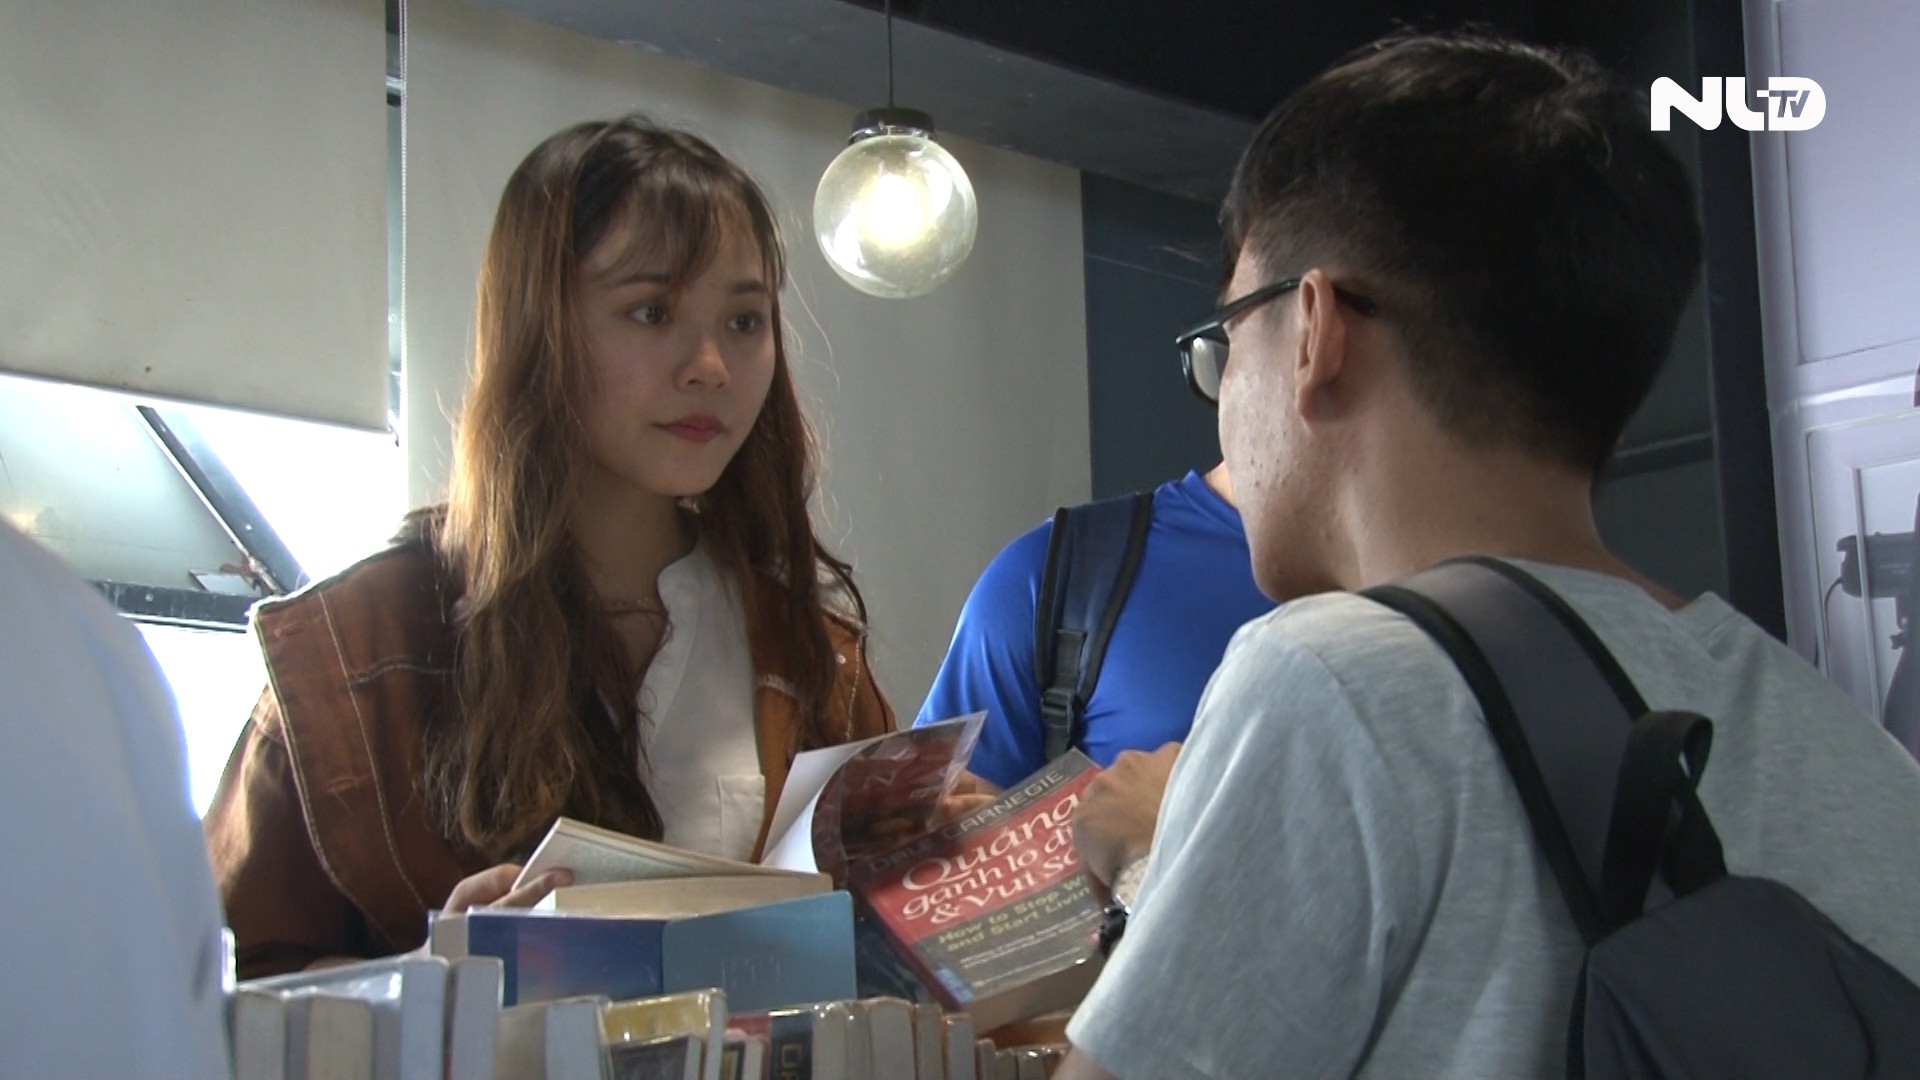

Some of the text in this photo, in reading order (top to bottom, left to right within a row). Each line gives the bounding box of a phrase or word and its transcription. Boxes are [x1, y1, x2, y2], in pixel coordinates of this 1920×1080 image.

[943, 770, 1065, 840] CARNEGIE
[1005, 849, 1039, 872] lo
[930, 903, 963, 924] &
[959, 868, 1037, 908] Vui
[939, 891, 1061, 944] How to Stop
[947, 931, 984, 952] and
[990, 910, 1039, 936] Start
[1045, 887, 1090, 914] Livin
